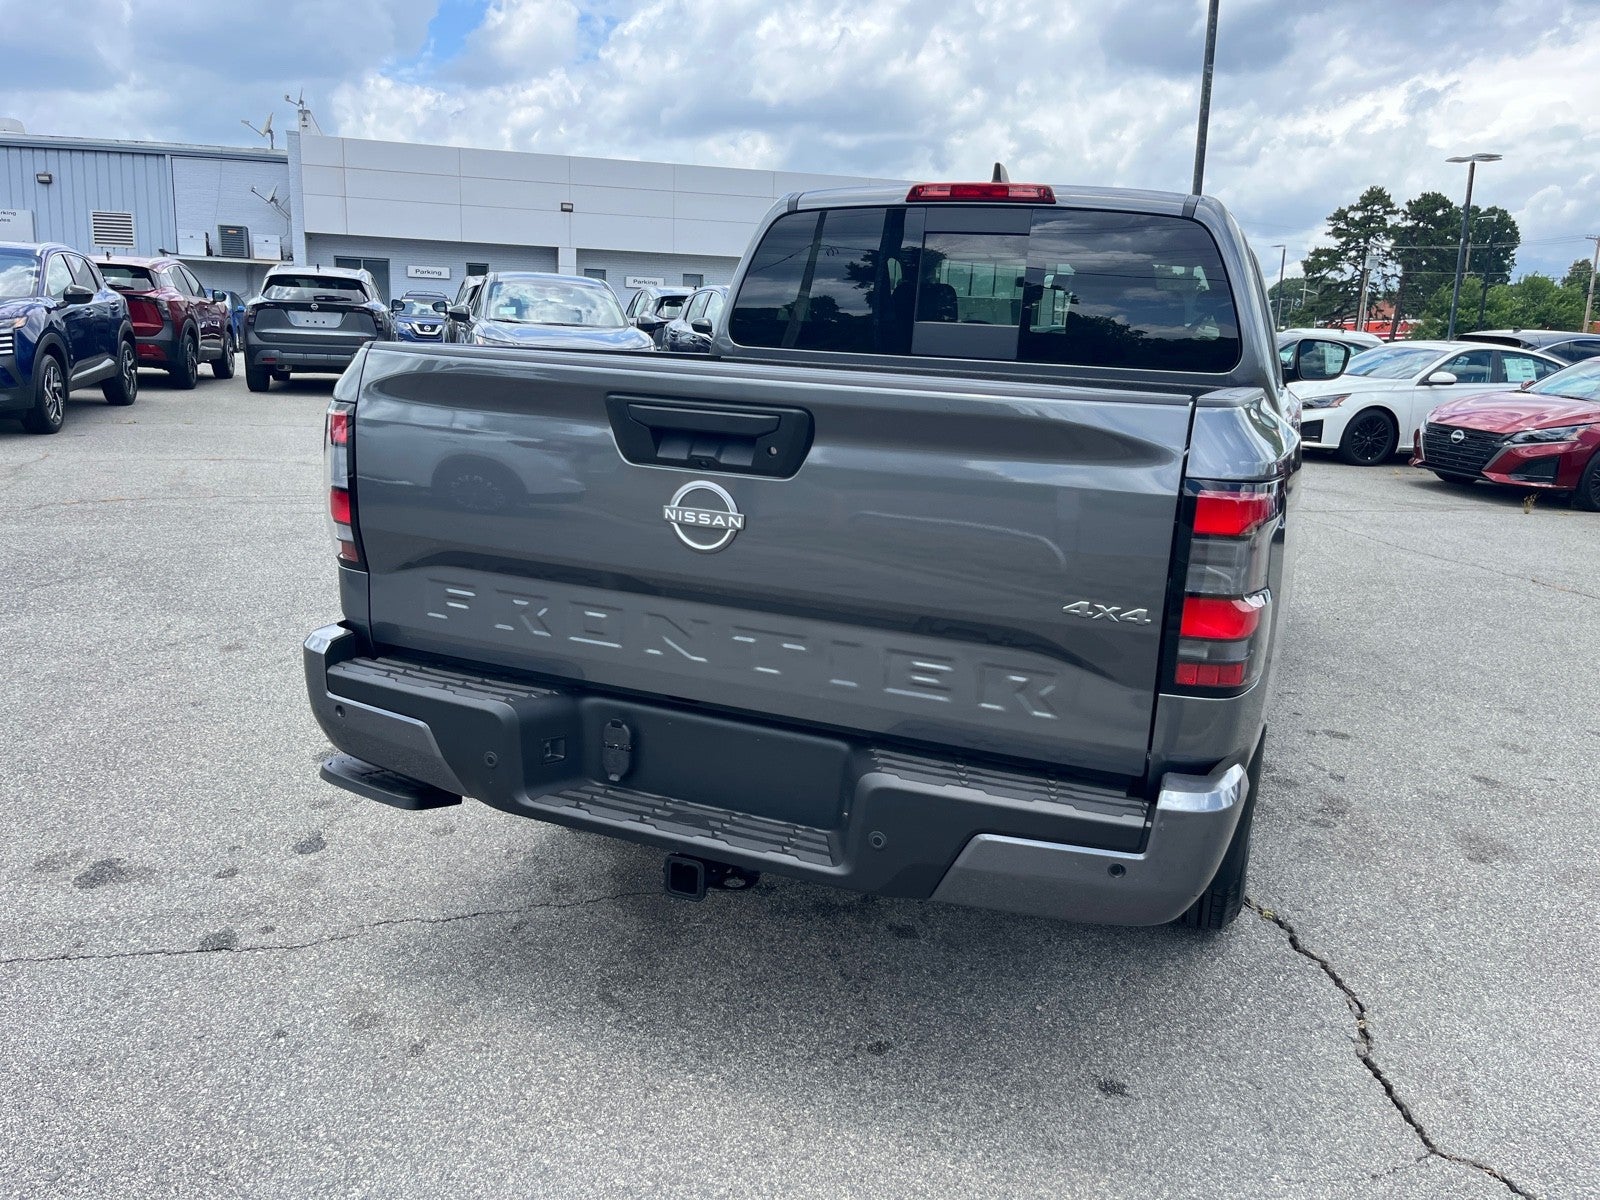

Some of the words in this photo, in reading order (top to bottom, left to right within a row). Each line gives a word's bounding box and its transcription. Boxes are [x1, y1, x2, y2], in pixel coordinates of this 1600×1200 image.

[415, 268, 442, 276] Parking
[633, 278, 658, 286] Parking
[664, 508, 742, 528] NISSAN
[427, 578, 1058, 719] FRONTIER
